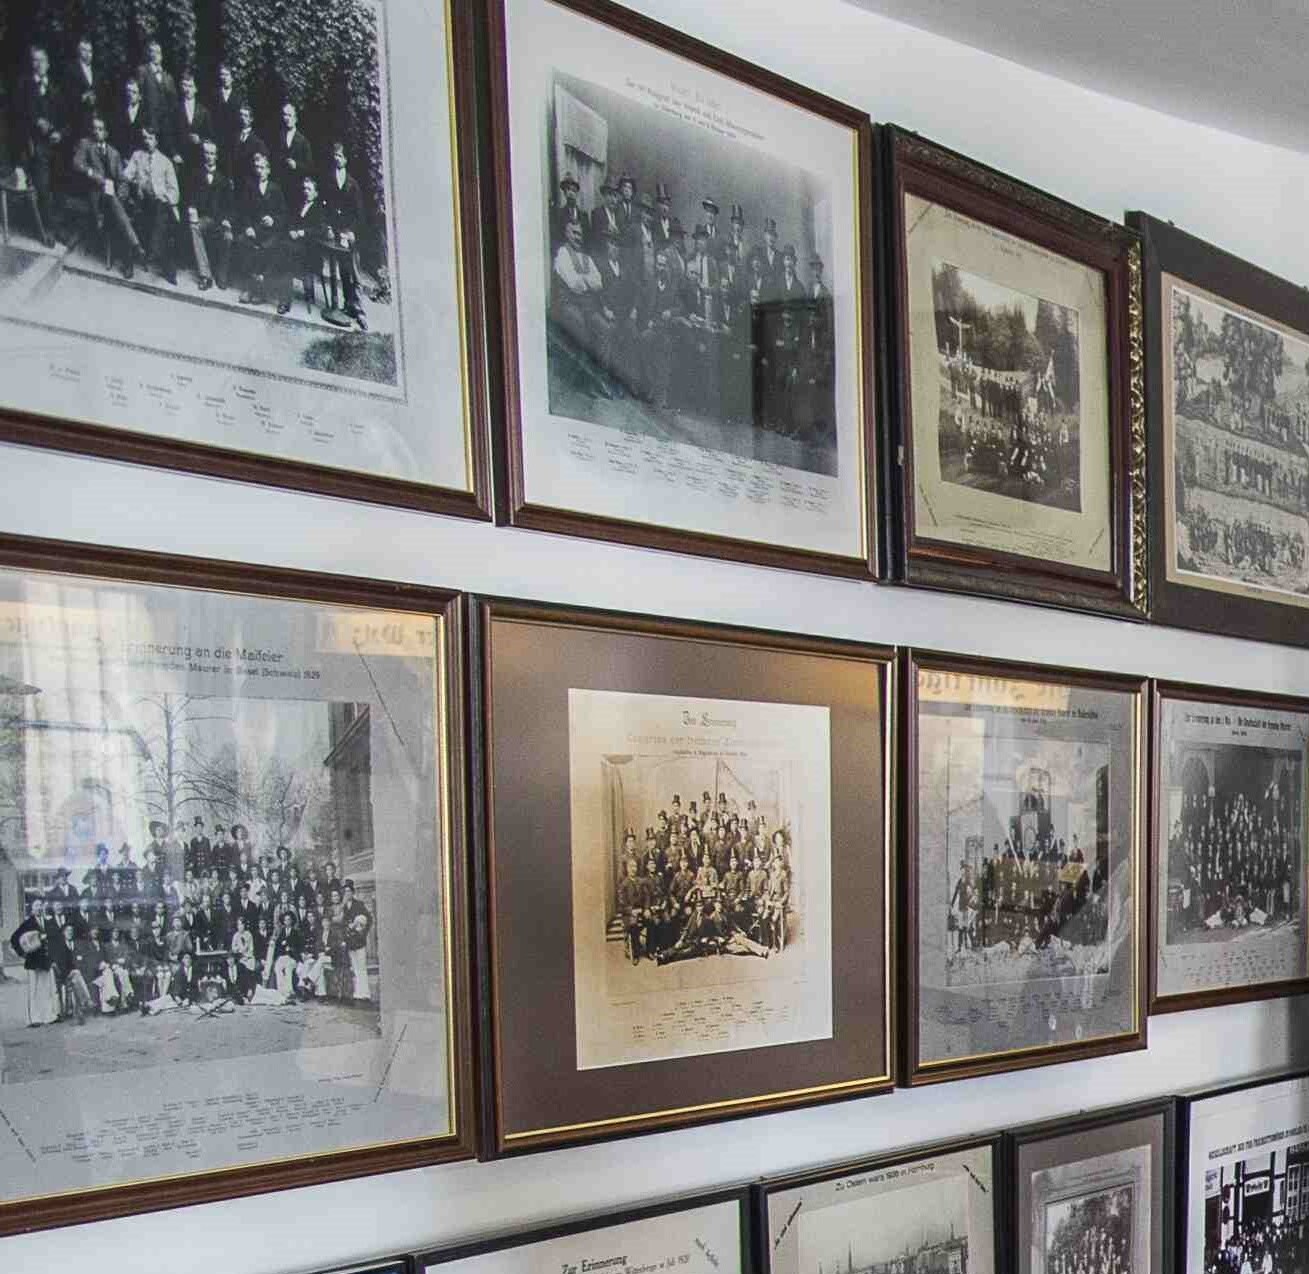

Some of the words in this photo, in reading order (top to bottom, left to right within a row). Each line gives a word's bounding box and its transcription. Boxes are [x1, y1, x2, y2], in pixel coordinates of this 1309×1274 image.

[195, 647, 210, 658] an
[213, 645, 233, 659] die
[581, 1255, 629, 1273] Erinnerung
